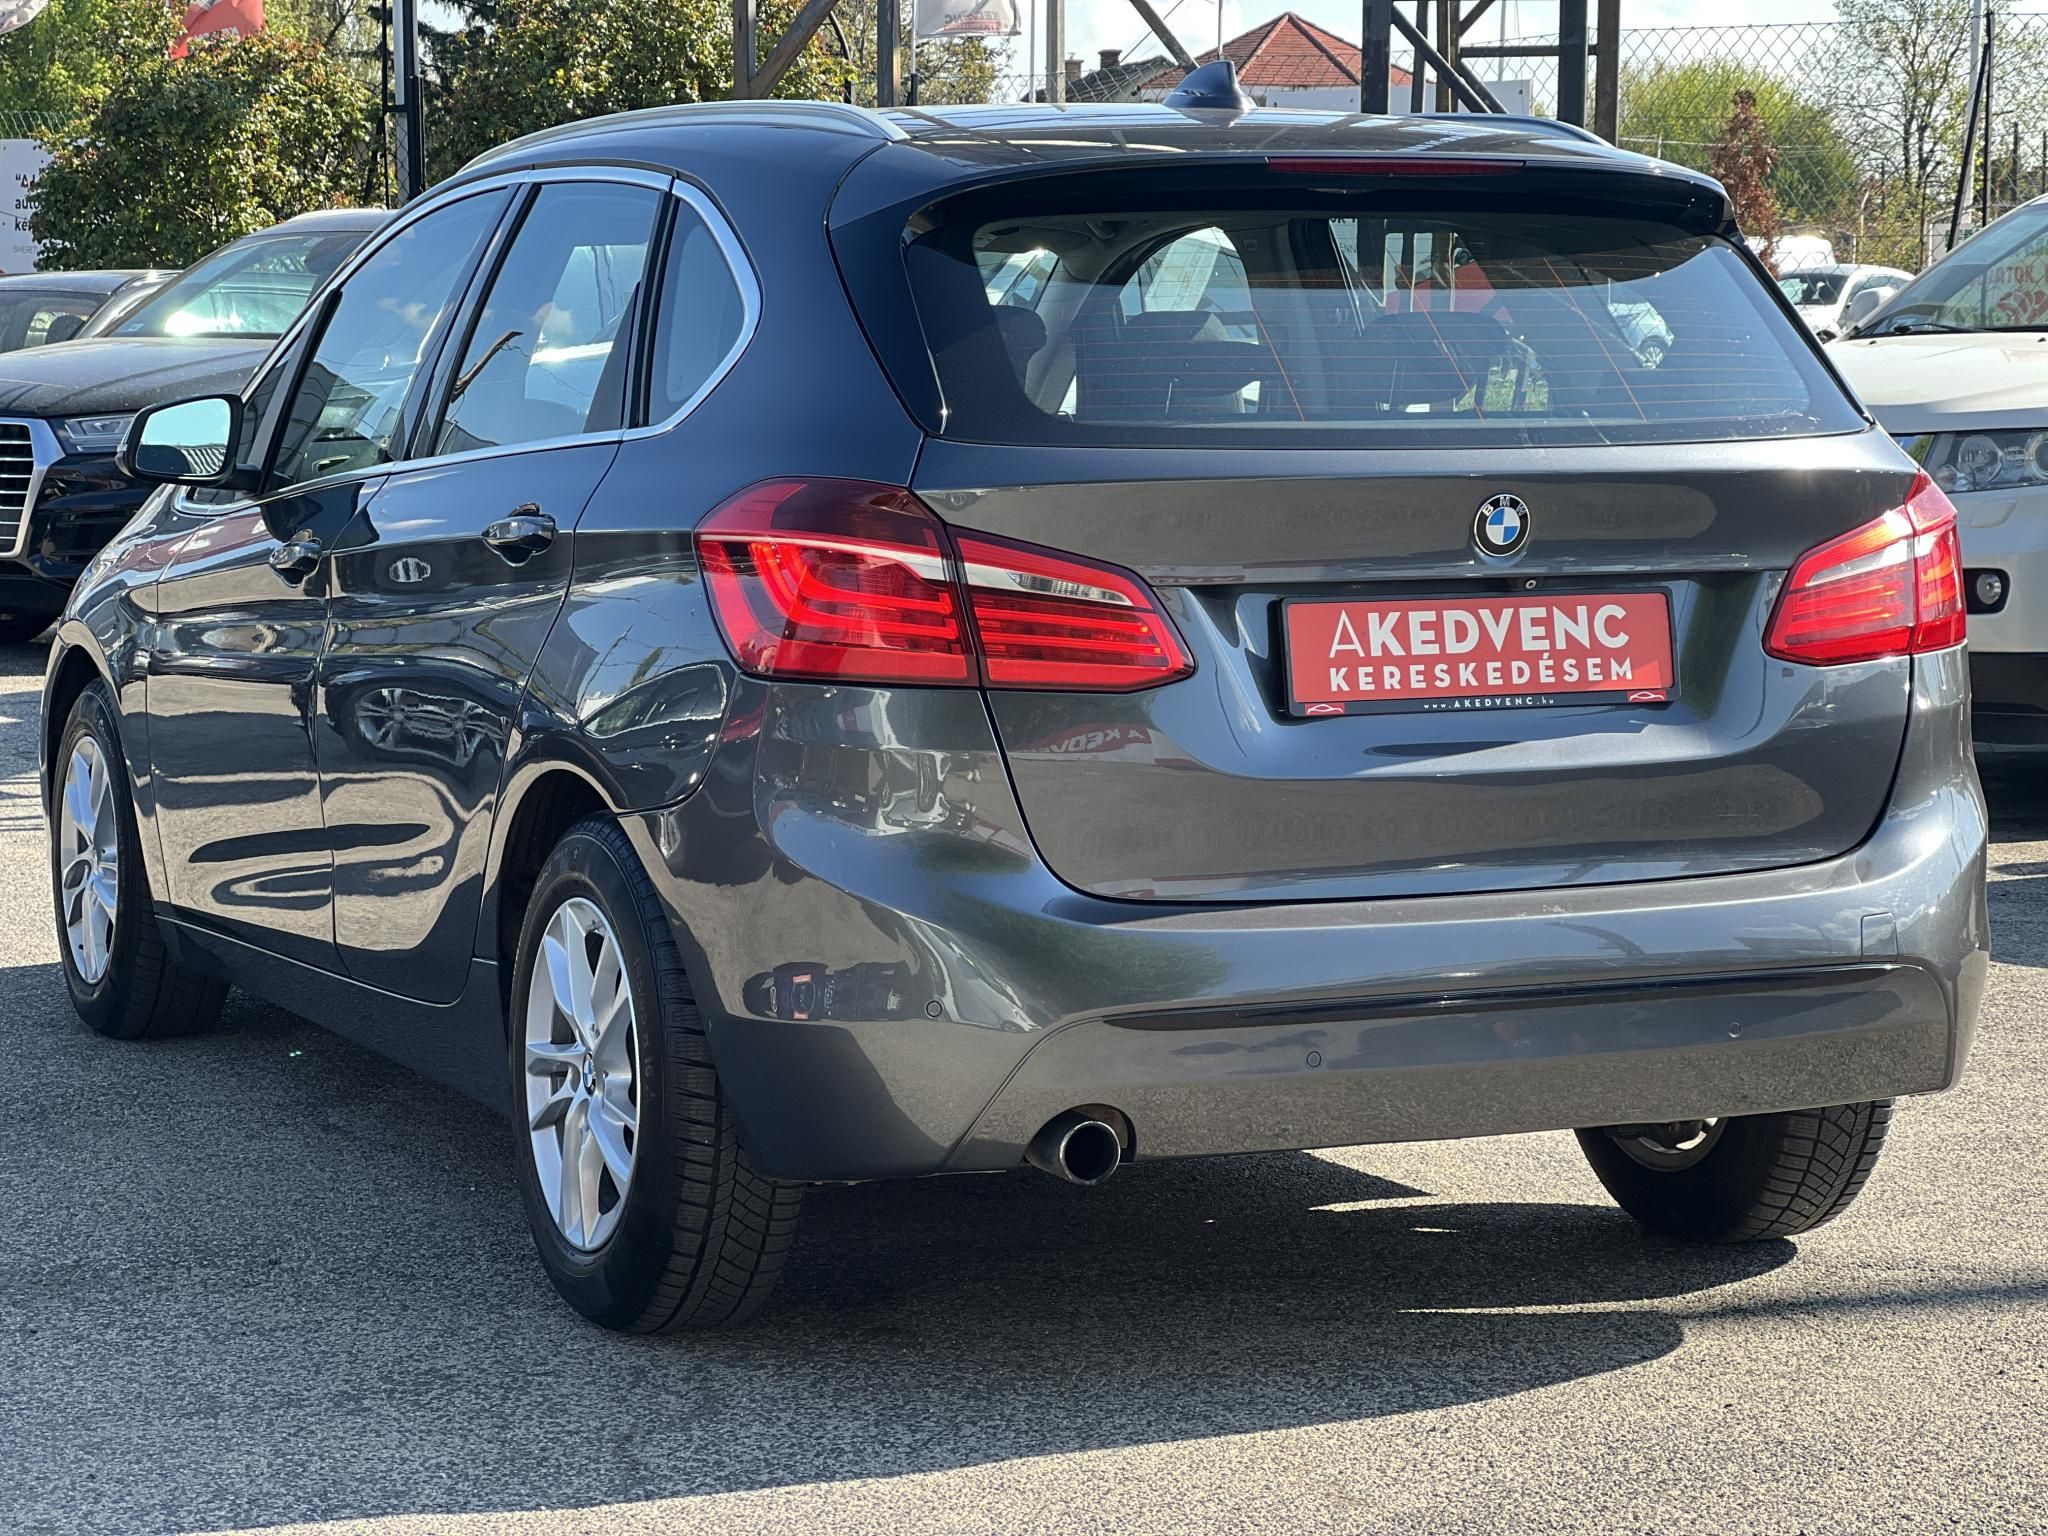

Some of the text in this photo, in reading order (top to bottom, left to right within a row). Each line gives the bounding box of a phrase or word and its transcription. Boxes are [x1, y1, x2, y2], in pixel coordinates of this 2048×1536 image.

[1482, 496, 1527, 516] BMW
[1329, 652, 1633, 692] KERESKEDÉSEM
[1423, 696, 1554, 709] www.AKEDVENC.hu
